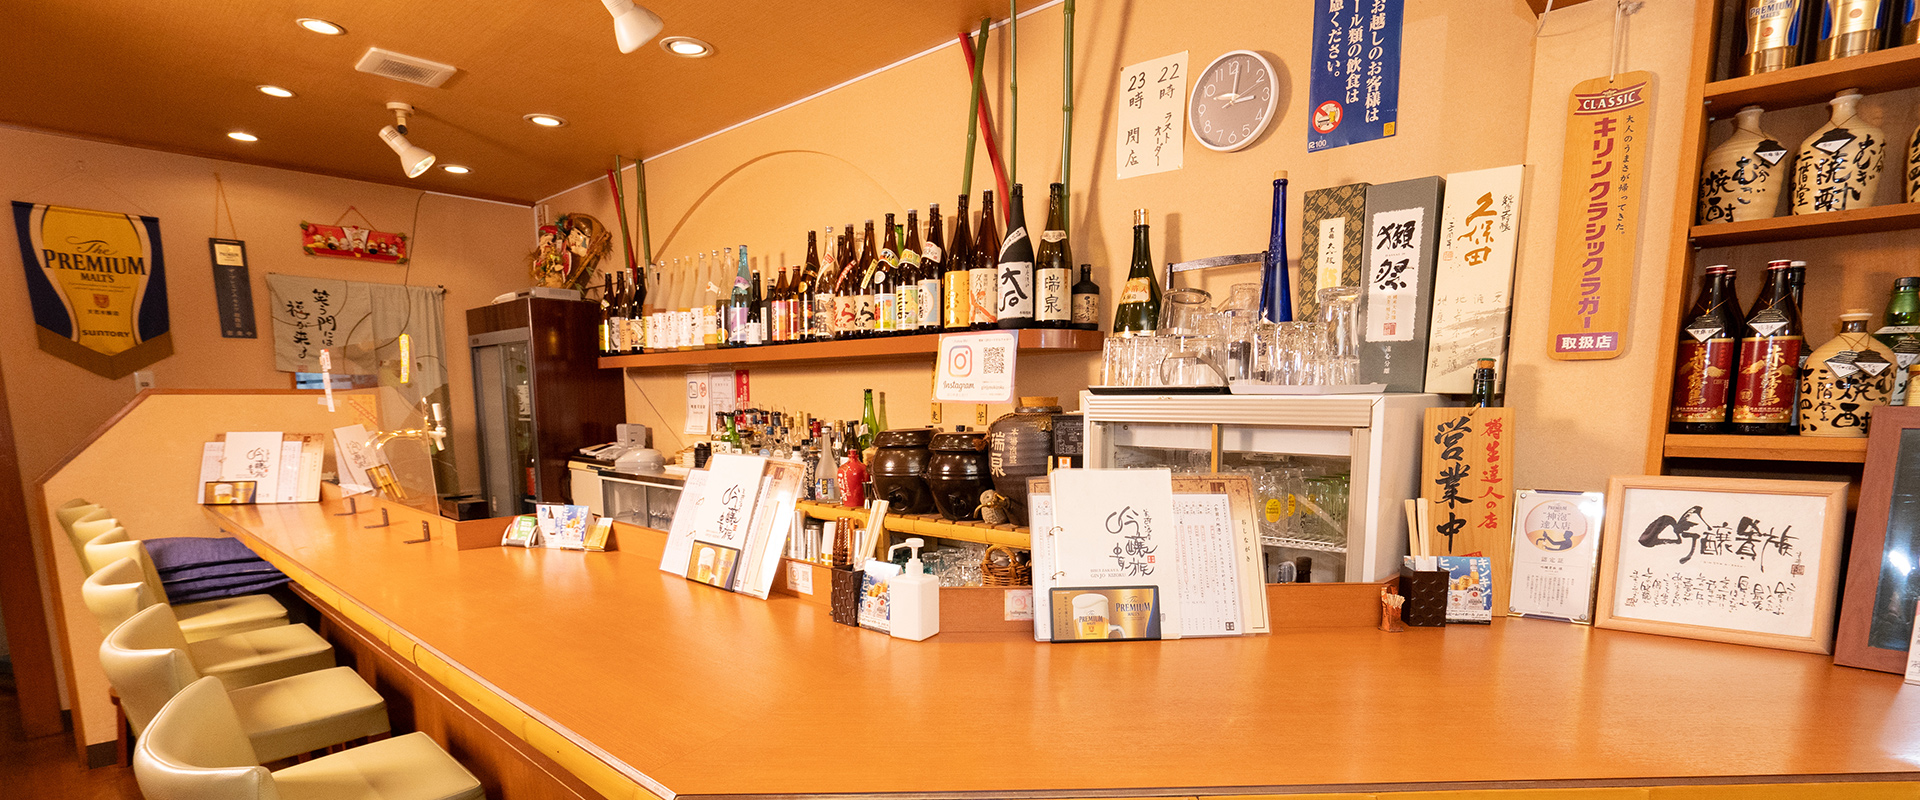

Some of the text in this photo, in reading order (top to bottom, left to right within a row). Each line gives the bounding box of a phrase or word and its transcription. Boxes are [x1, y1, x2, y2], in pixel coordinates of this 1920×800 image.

[1750, 1, 1793, 17] PREMIUM
[1246, 60, 1250, 73] 1
[1157, 63, 1179, 99] 22時
[1215, 69, 1223, 82] 11
[1256, 69, 1265, 83] 2
[1127, 71, 1146, 109] 23時
[1204, 84, 1216, 98] 10
[1262, 87, 1270, 101] 3
[1583, 91, 1636, 110] CLASSIC
[1198, 104, 1206, 117] 9
[1255, 108, 1263, 120] 4
[1163, 111, 1172, 143] ラスト
[1204, 120, 1211, 134] 8
[1242, 124, 1250, 137] 5
[1216, 130, 1224, 142] 7
[1228, 131, 1237, 144] 6
[1615, 115, 1634, 235] 大人のうまさが帰ってきた。
[1457, 191, 1497, 267] 久保田
[1578, 117, 1617, 329] キリンクラシックラガー
[42, 248, 148, 275] PREMIUM
[1373, 219, 1416, 291] 獺祭
[81, 272, 115, 283] MALT'S
[1044, 273, 1062, 314] 瑞泉
[82, 329, 130, 338] SUNTORY
[1561, 334, 1612, 350] 取扱店
[943, 380, 975, 392] Instagram
[990, 431, 1007, 478] 瑞泉
[1477, 417, 1506, 529] 樽生達人の店
[1434, 415, 1474, 555] 営業中
[1540, 520, 1571, 531] 達人店
[1115, 602, 1151, 612] PREMIUM
[1079, 615, 1104, 623] PREMIUM
